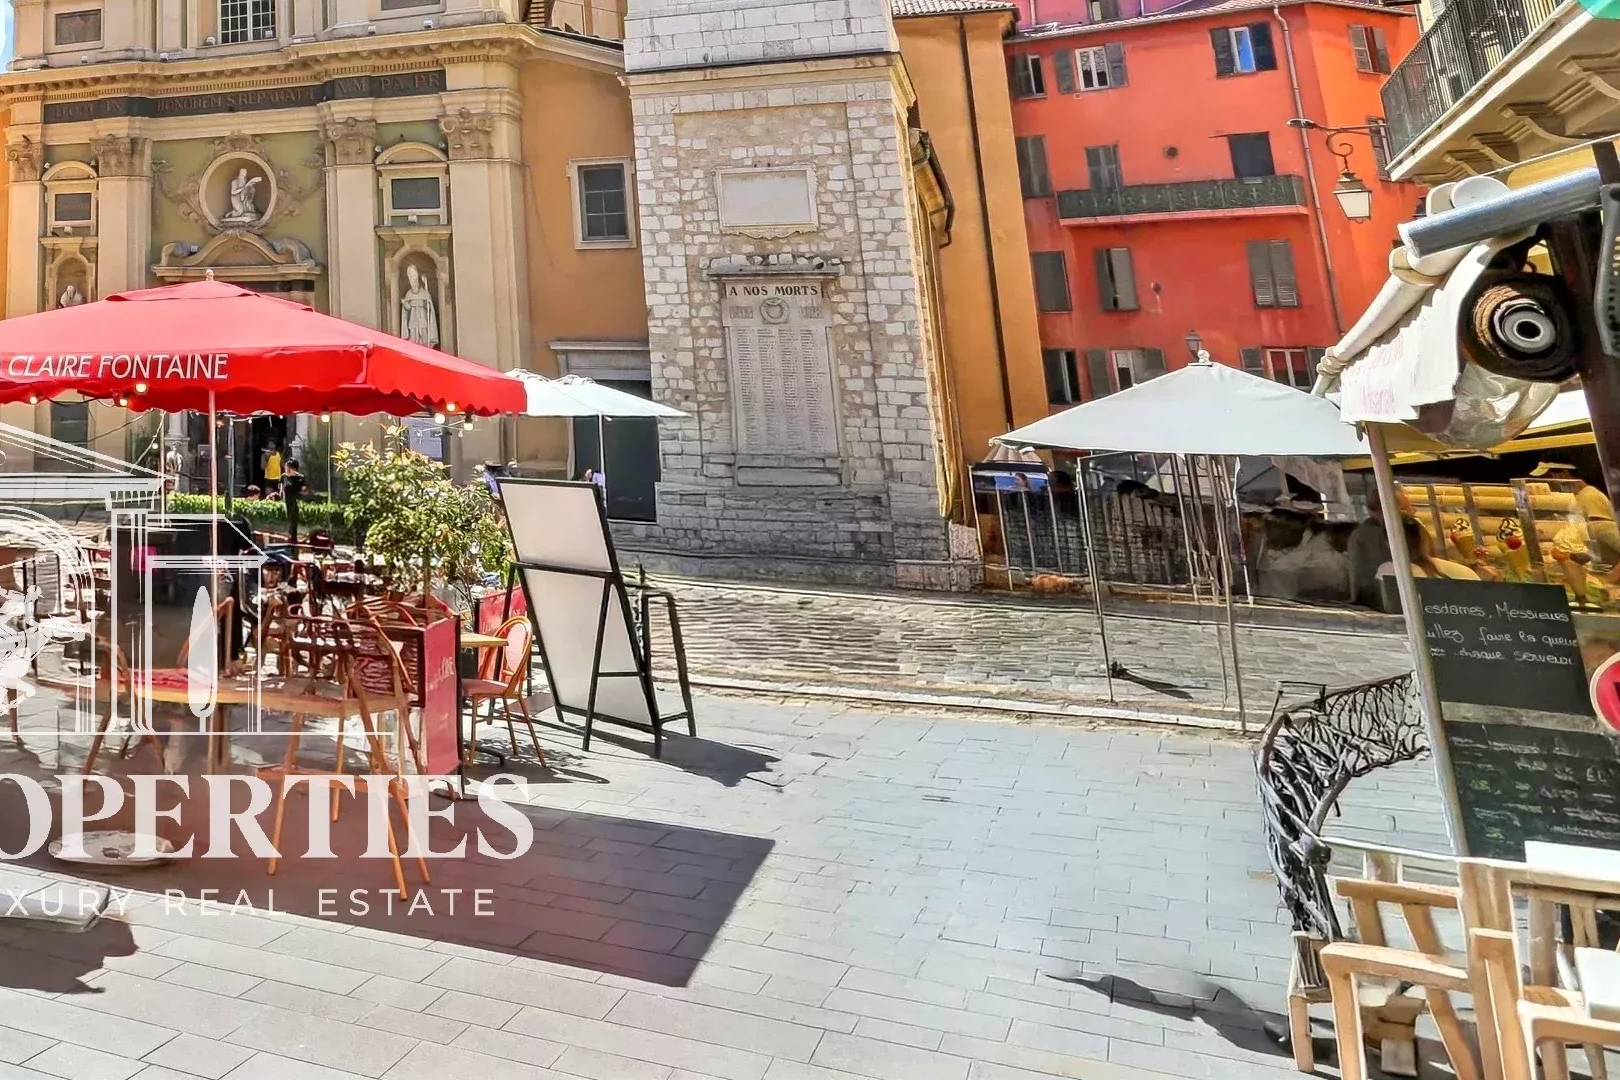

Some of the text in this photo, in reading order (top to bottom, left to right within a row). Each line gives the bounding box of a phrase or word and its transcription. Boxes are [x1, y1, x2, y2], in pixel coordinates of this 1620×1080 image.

[730, 285, 818, 296] A NOS MORTS
[8, 354, 93, 379] CLAIRE
[97, 353, 229, 380] FONTAINE
